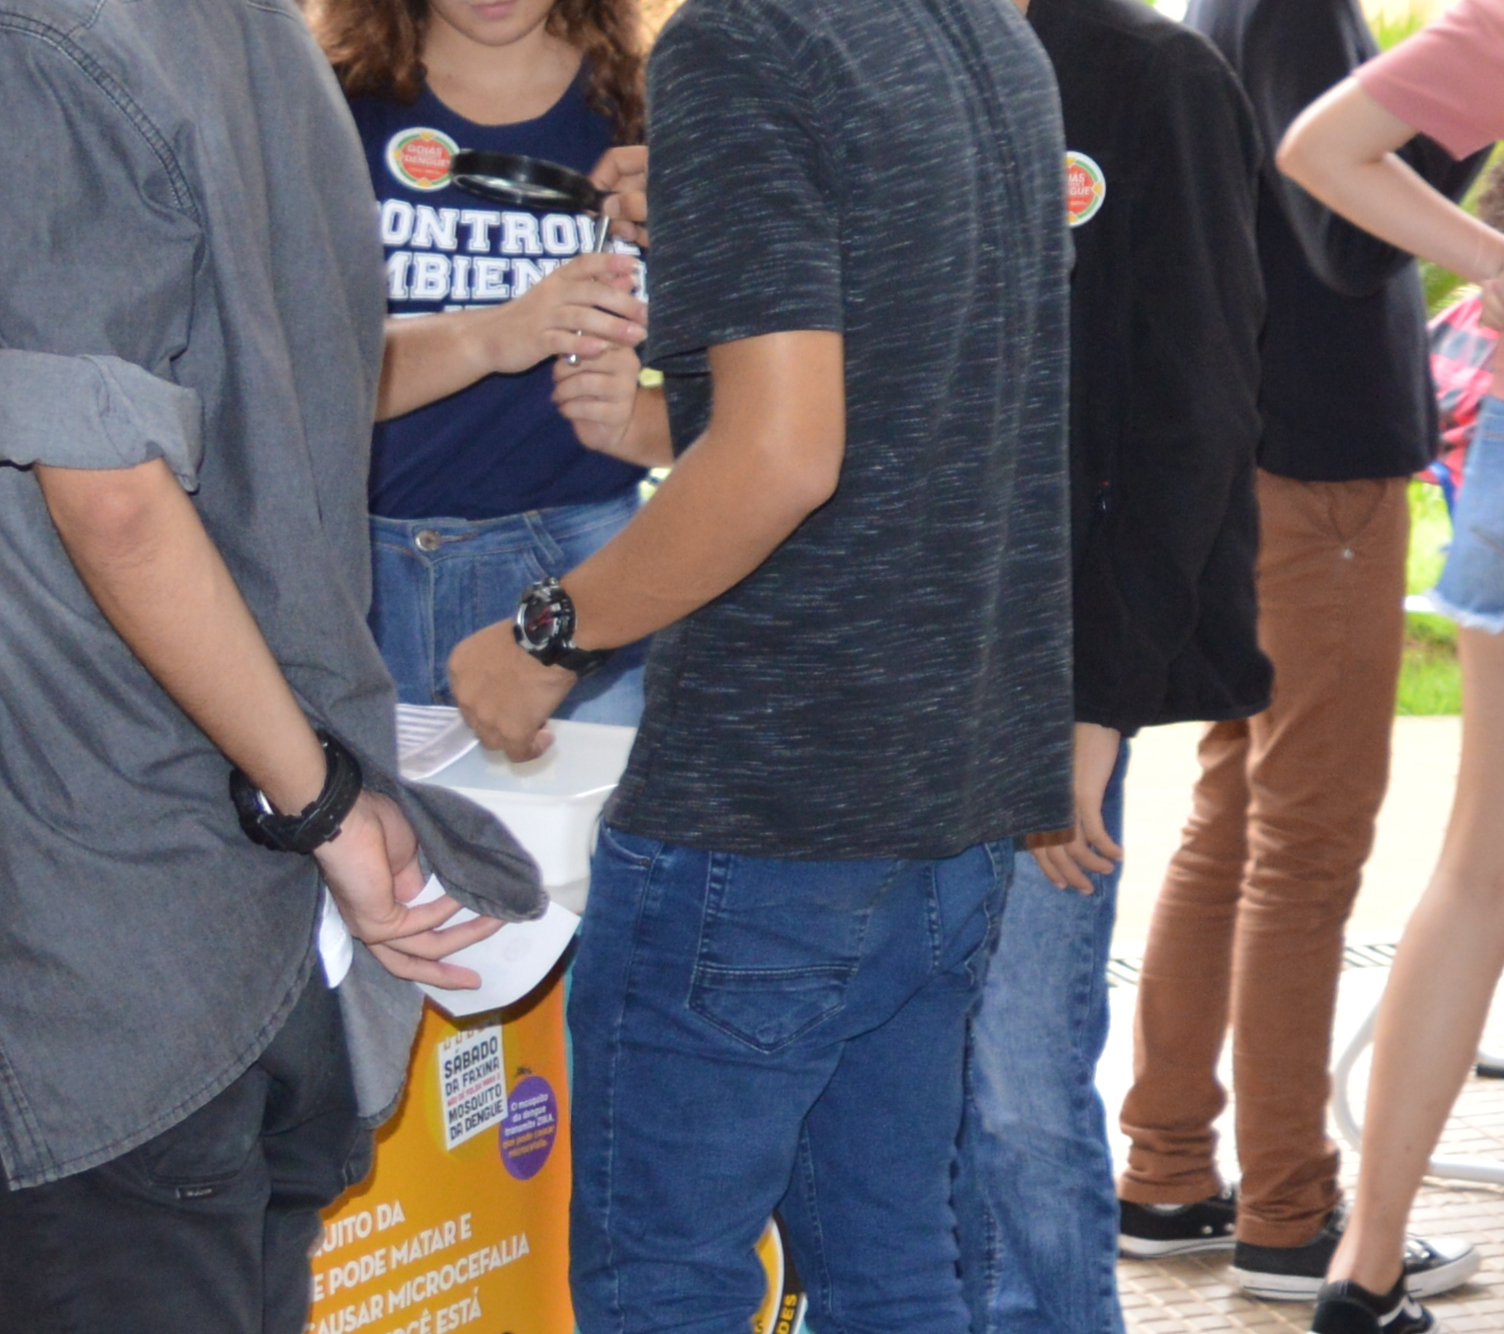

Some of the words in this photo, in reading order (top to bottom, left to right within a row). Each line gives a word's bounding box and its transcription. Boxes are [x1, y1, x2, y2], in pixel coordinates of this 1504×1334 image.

[444, 1036, 498, 1079] SÁBADO
[445, 1078, 460, 1097] DA
[462, 1056, 500, 1087] FAXINA
[448, 1083, 502, 1124] MOSQUITO
[450, 1122, 463, 1141] DA
[465, 1099, 504, 1132] DENGUE
[377, 1199, 406, 1232] DA
[330, 1248, 386, 1295] PODE
[391, 1221, 457, 1269] MATAR
[460, 1212, 473, 1241] E
[388, 1231, 530, 1314] MICROCEFALIA
[436, 1286, 482, 1334] ESTÁ
